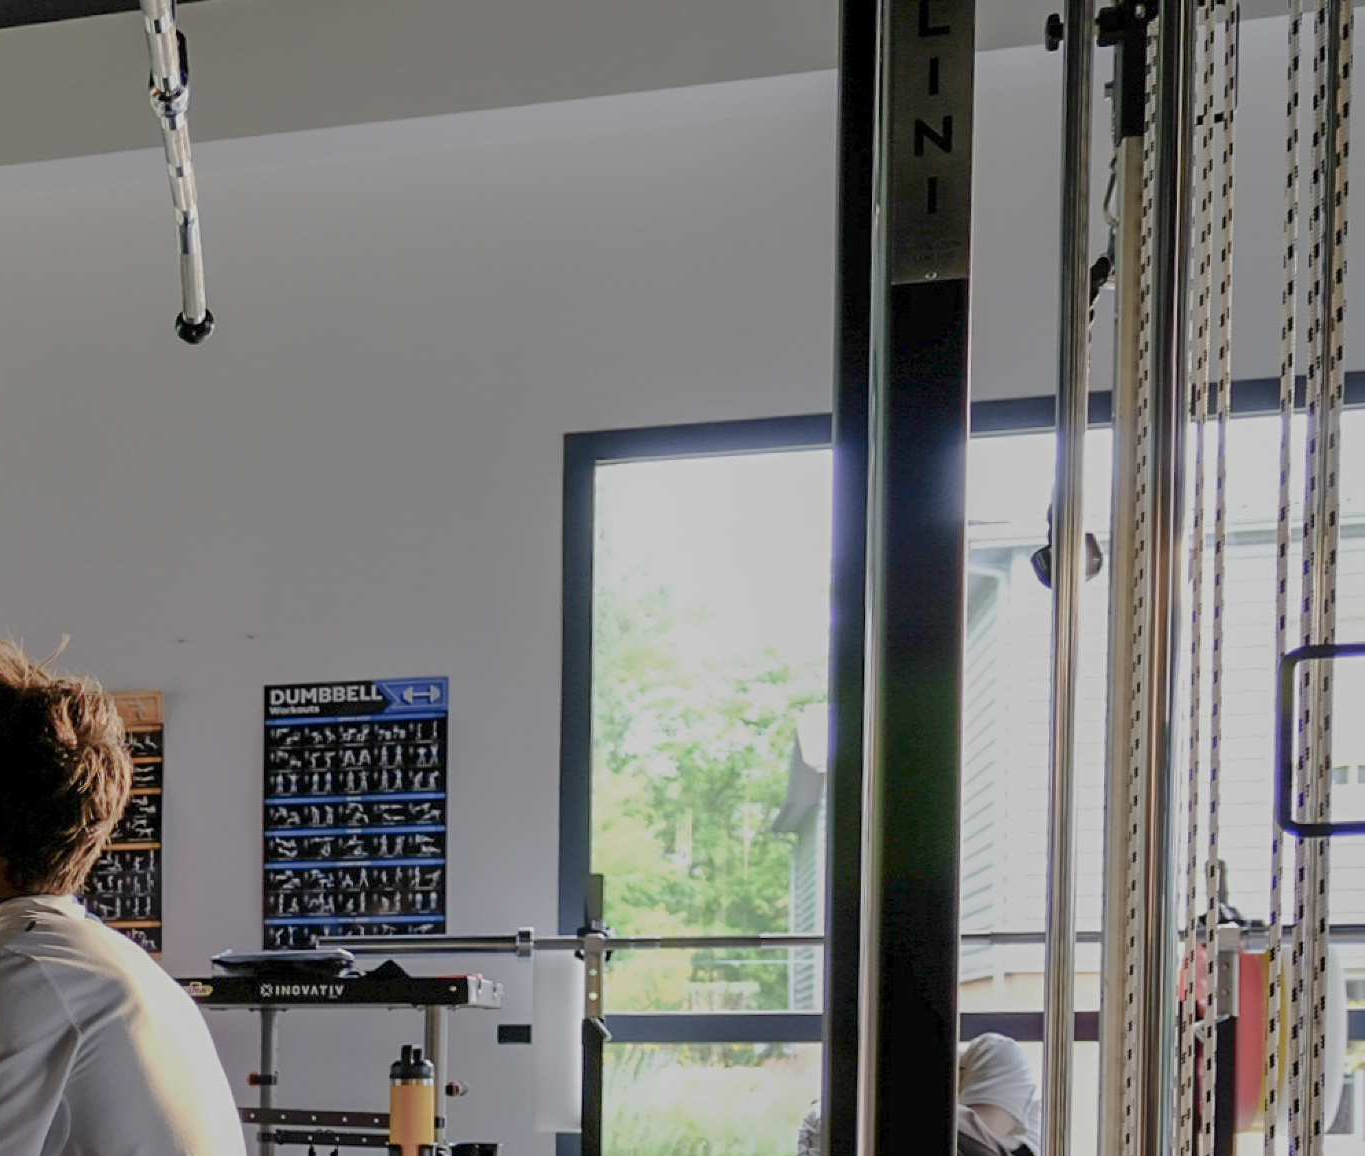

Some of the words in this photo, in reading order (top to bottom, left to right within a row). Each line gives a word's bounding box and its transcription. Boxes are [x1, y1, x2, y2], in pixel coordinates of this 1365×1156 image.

[270, 684, 383, 705] DUMBBELL
[269, 705, 320, 715] Workouts
[275, 984, 345, 997] INOVATIV
